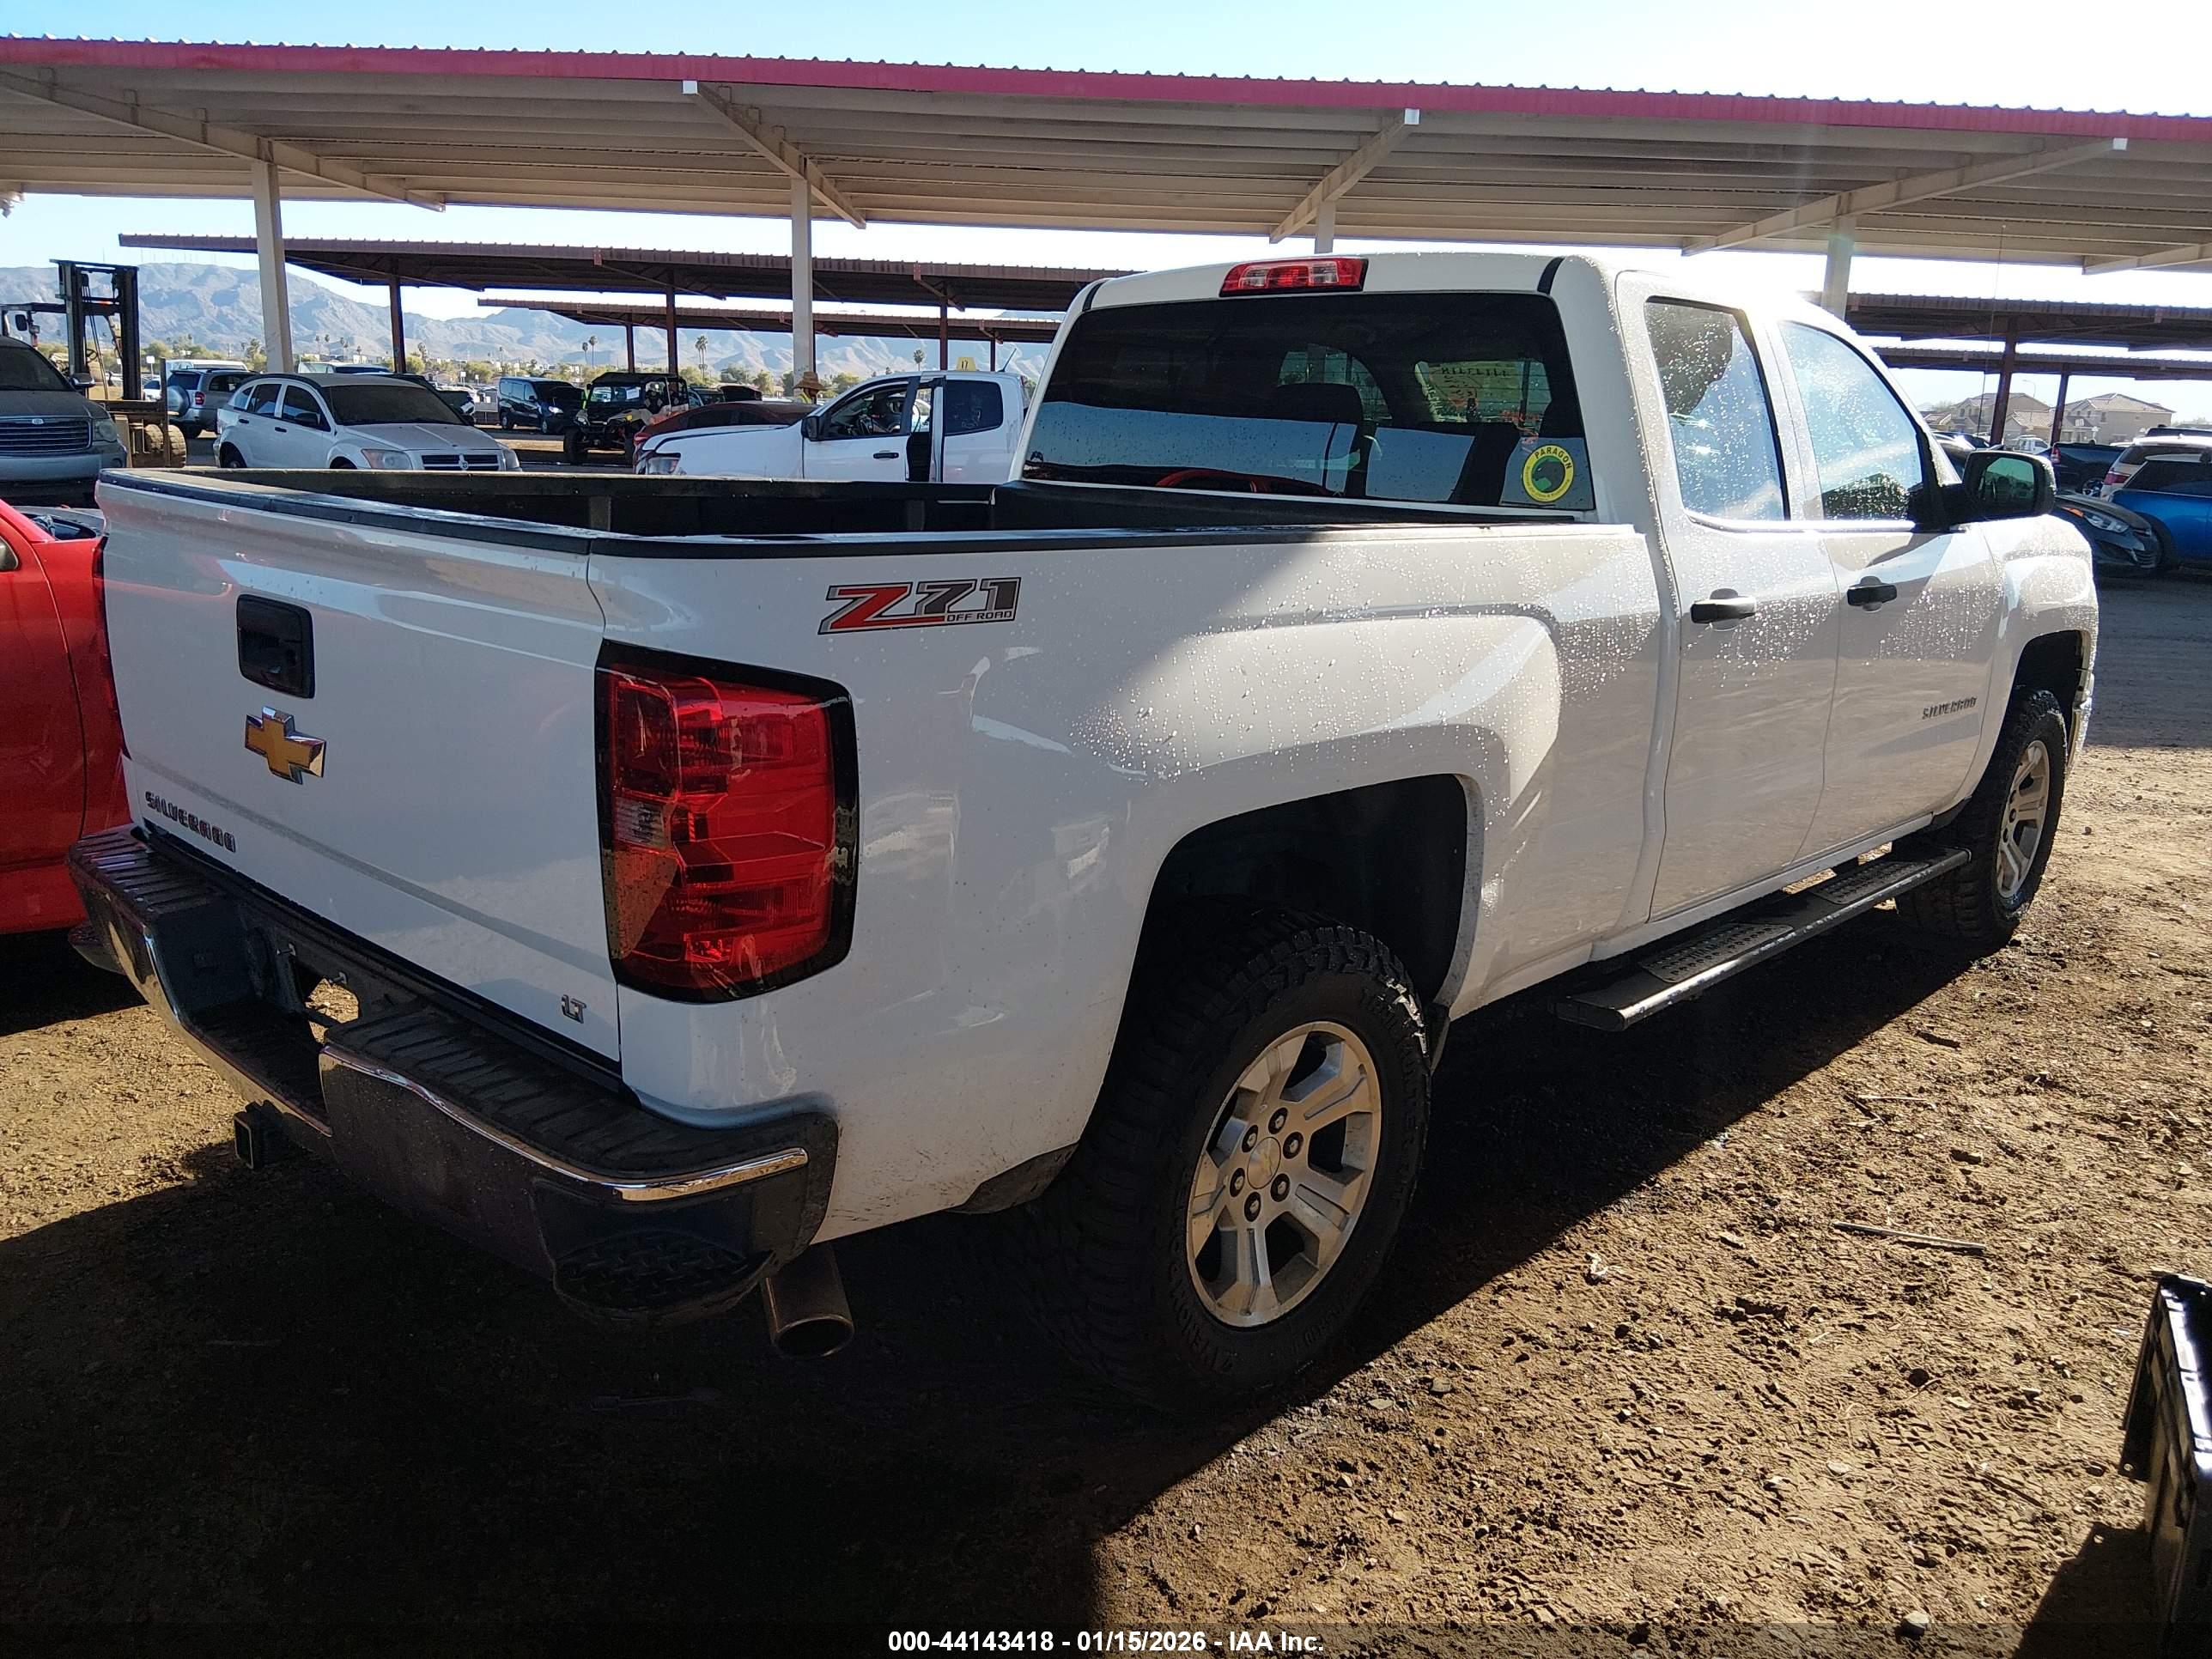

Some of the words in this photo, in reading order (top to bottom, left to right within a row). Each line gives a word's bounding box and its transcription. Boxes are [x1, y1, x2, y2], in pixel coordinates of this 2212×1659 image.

[1534, 447, 1572, 470] PARAGON
[817, 577, 1021, 635] Z71
[947, 613, 973, 623] OFF
[976, 611, 1012, 620] ROAD
[144, 790, 236, 854] SILVERADO
[561, 994, 587, 1024] LT
